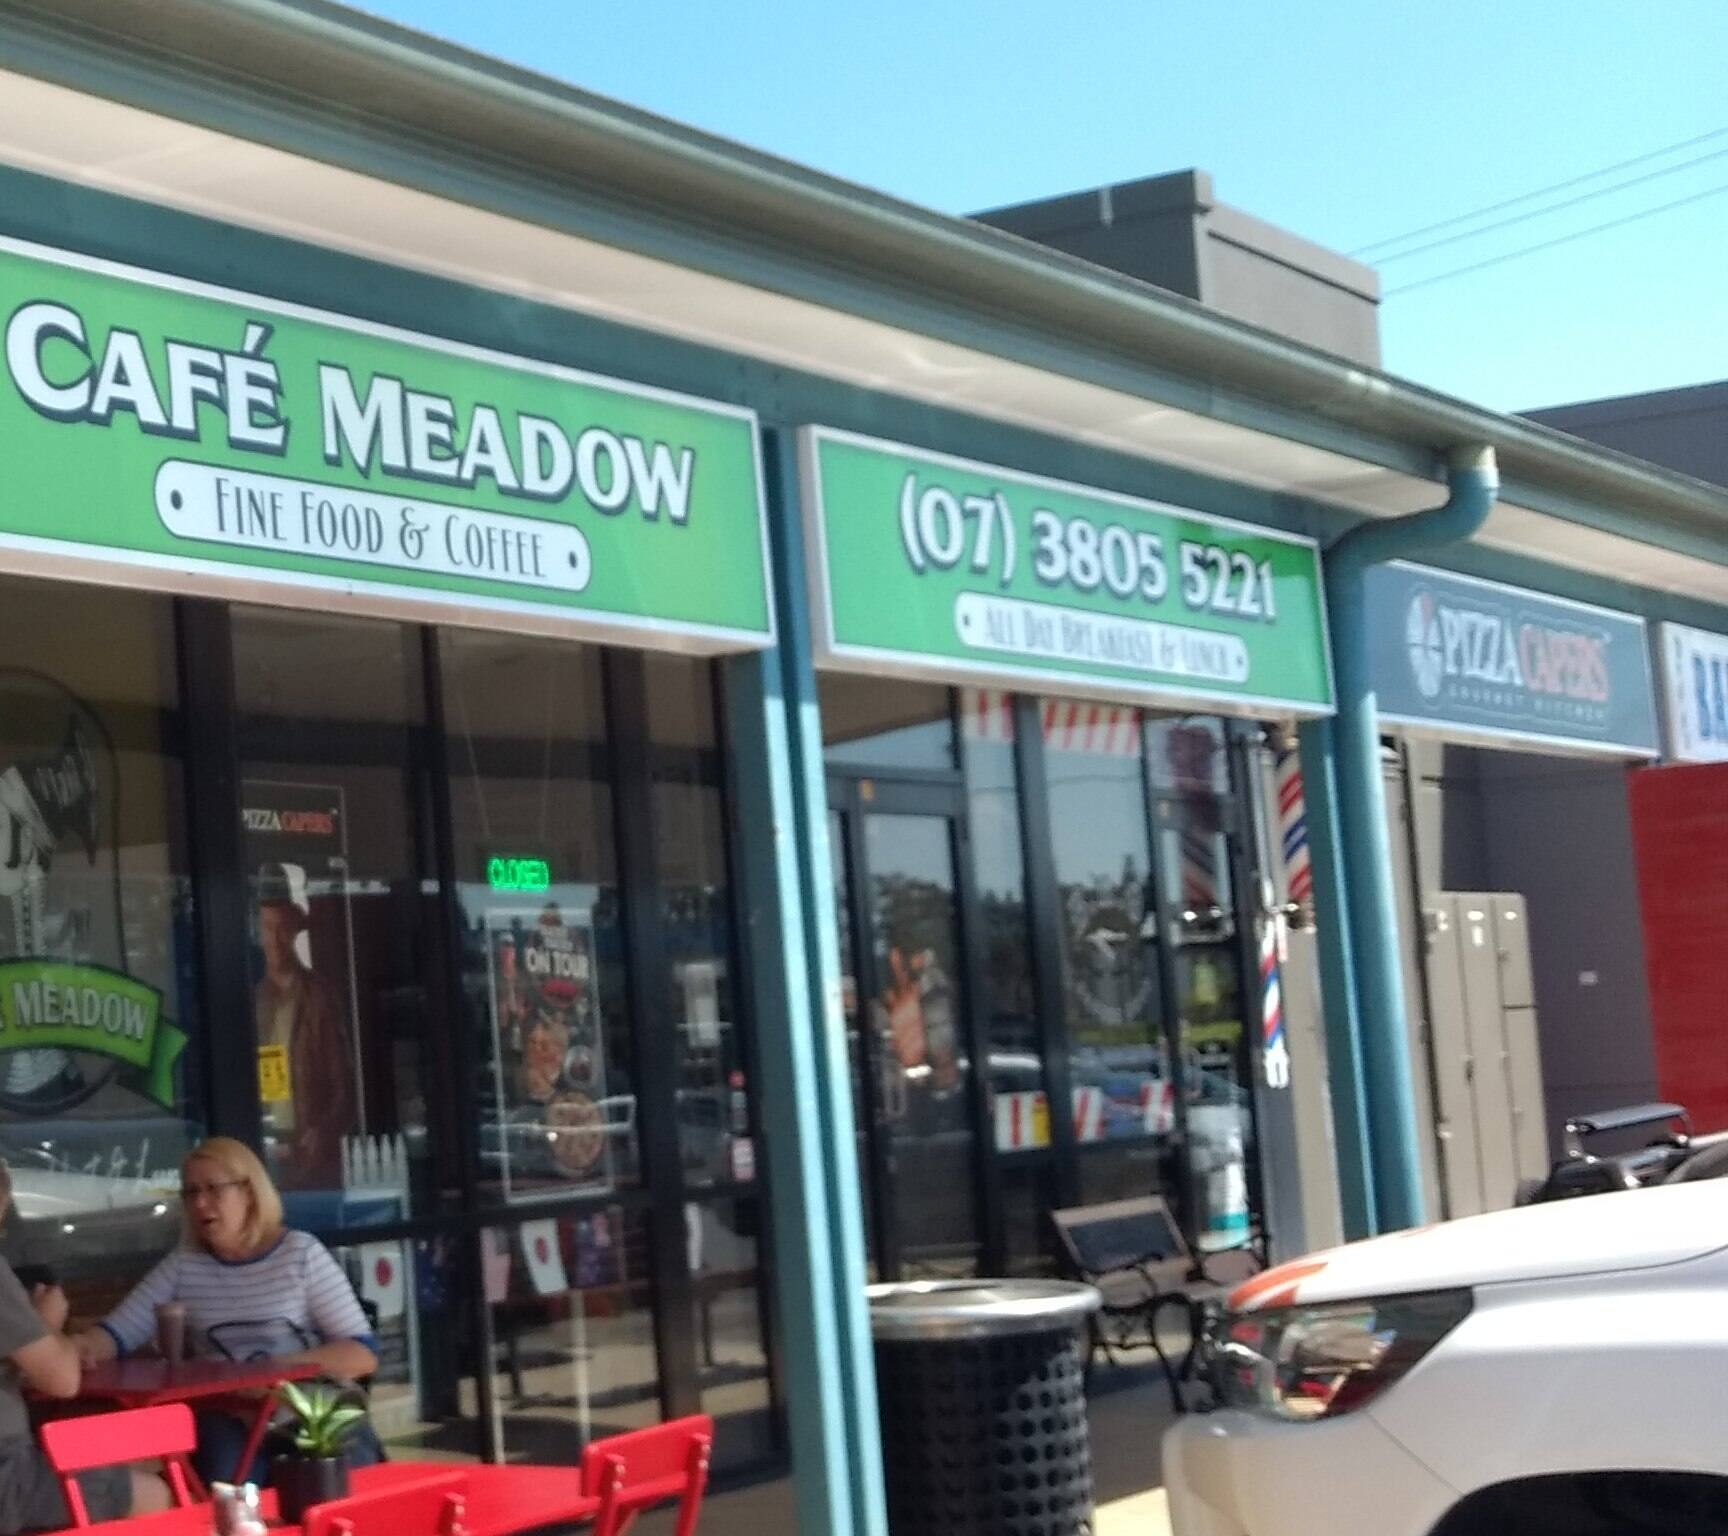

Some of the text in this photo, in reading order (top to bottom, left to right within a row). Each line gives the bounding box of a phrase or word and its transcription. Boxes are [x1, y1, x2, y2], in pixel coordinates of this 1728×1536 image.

[4, 300, 696, 526] CAFÉ MEADOW
[214, 476, 547, 580] FINE FOOD & COFFEE
[900, 469, 1278, 626] (07) 3805 5221
[1439, 605, 1523, 686] PIZZA
[12, 979, 148, 1041] MEADOW
